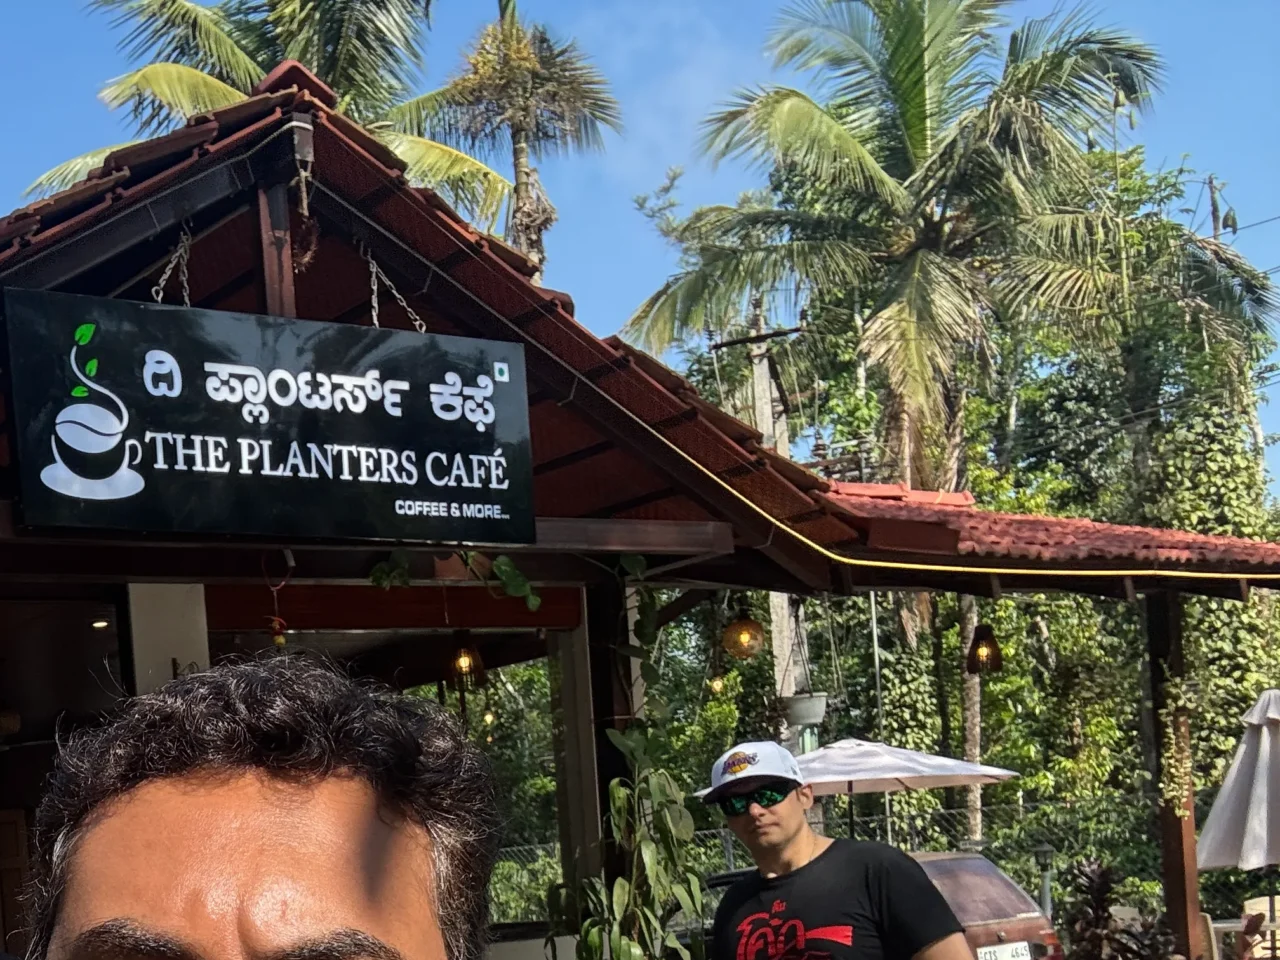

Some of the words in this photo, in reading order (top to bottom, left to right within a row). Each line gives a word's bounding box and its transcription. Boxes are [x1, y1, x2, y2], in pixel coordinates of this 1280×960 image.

[143, 349, 183, 398] ದಿ
[145, 431, 229, 474] THE
[238, 437, 418, 486] PLANTERS
[425, 448, 510, 490] CAFÉ
[395, 499, 448, 517] COFFEE
[450, 503, 461, 517] &
